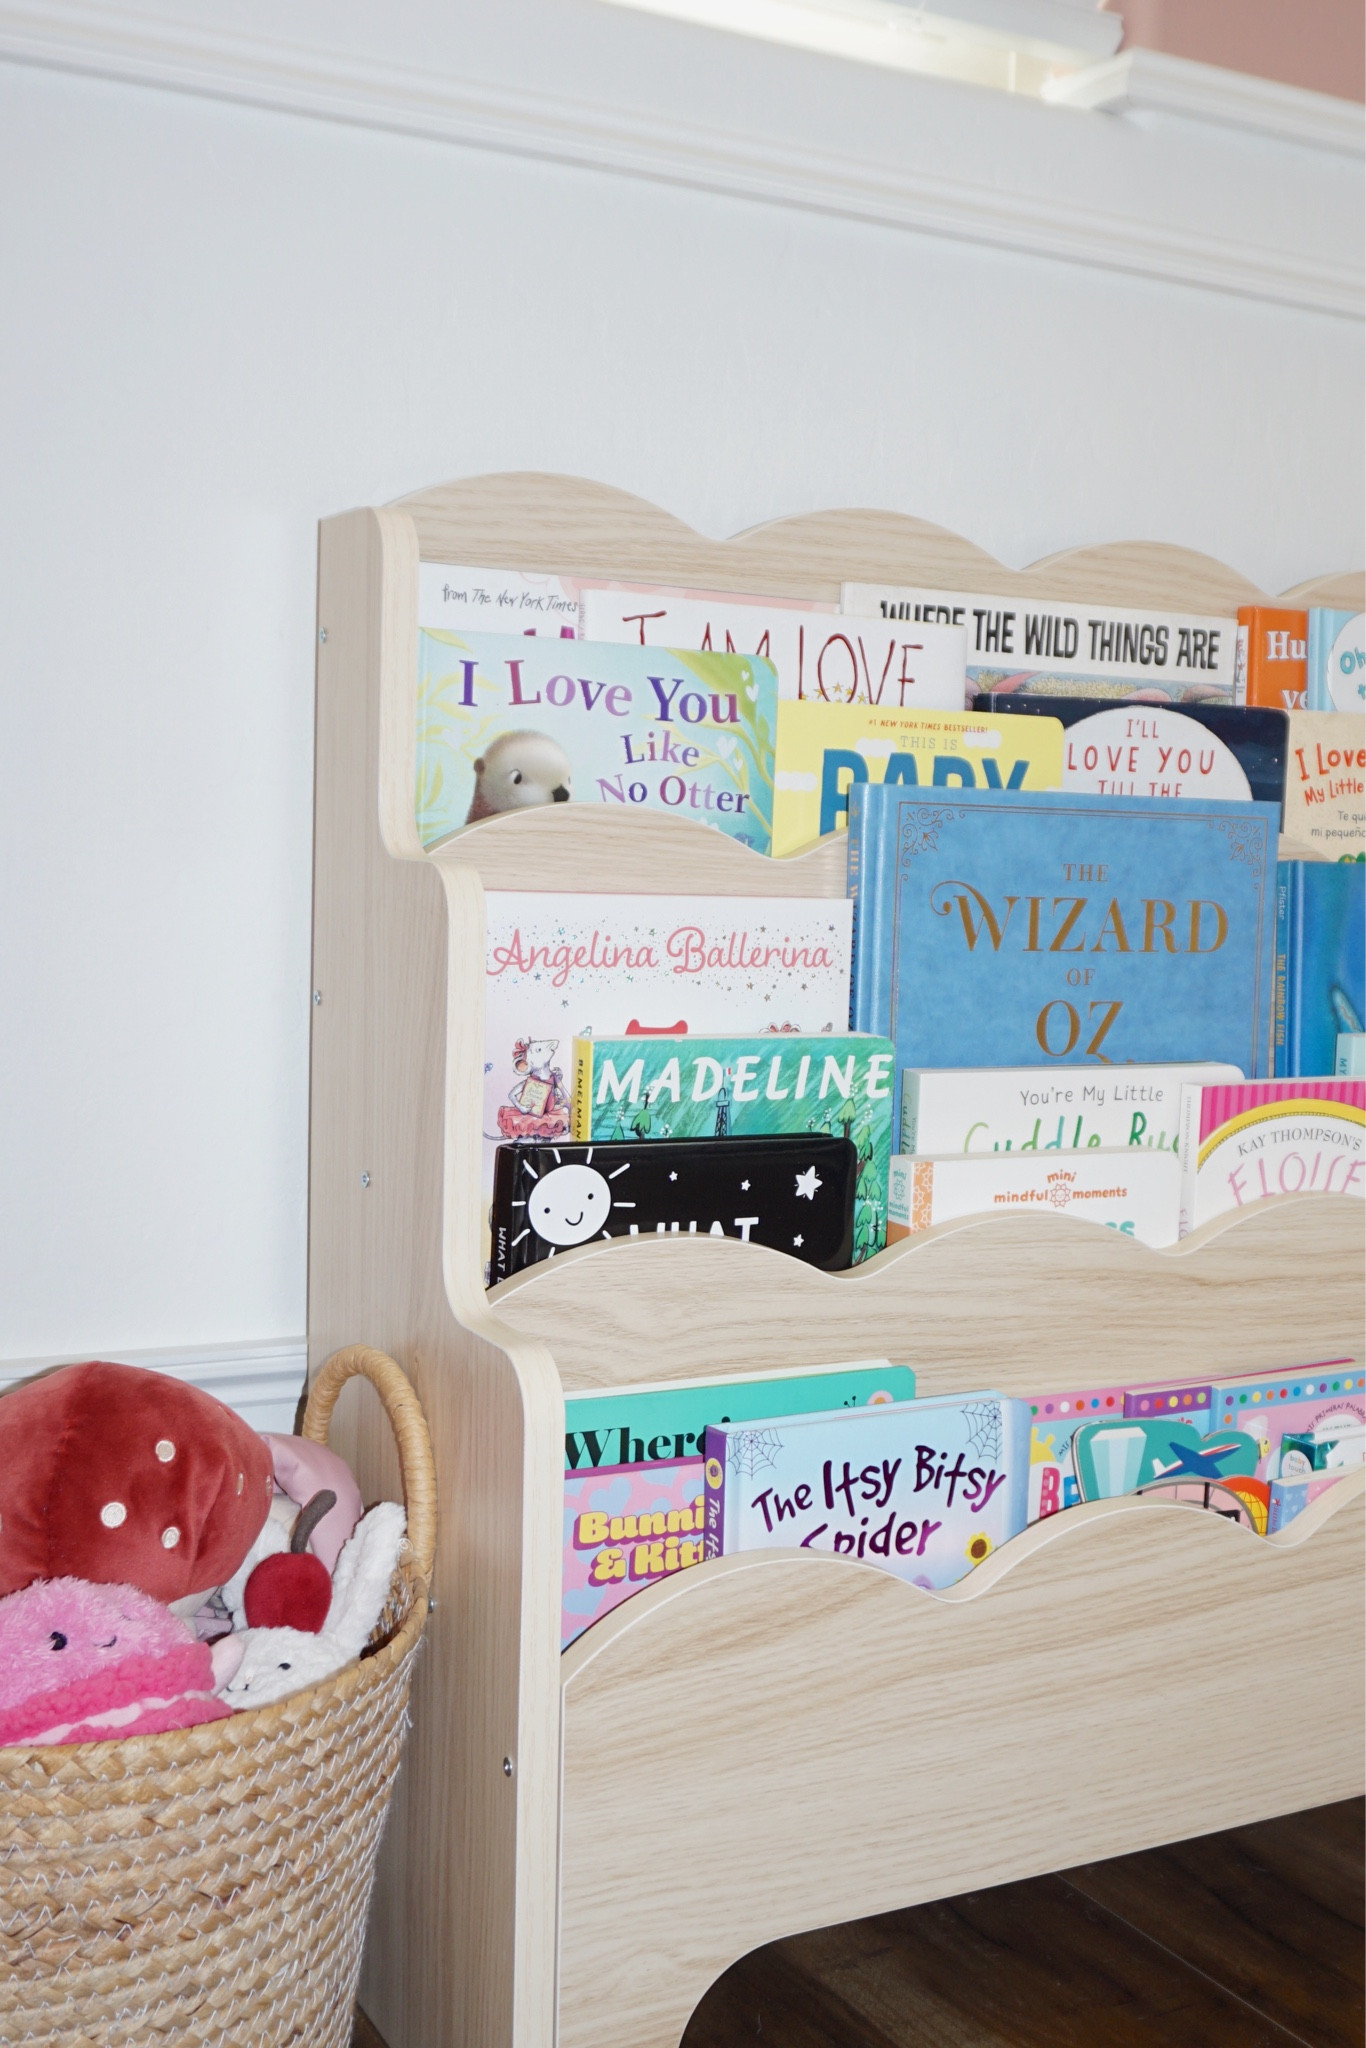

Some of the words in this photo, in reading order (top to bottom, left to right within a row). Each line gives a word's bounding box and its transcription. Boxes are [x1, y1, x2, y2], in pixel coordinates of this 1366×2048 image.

[442, 584, 467, 603] from
[472, 588, 492, 605] The
[496, 589, 518, 607] New
[519, 591, 544, 611] York
[546, 594, 578, 613] Times
[973, 608, 1016, 653] THE
[1025, 613, 1080, 659] WILD
[1088, 619, 1170, 666] THINGS
[1176, 627, 1222, 670] ARE
[458, 660, 478, 707] I
[504, 659, 633, 717] Love
[646, 676, 741, 724] You
[880, 720, 898, 728] NEW
[900, 722, 918, 730] YORK
[920, 722, 941, 731] TIMES
[944, 724, 988, 734] BESTSELLER!
[1126, 719, 1159, 739] I'LL
[620, 730, 700, 768] Like
[900, 736, 936, 749] THIS
[944, 738, 958, 751] IS
[1068, 742, 1140, 772] LOVE
[1158, 746, 1215, 775] YOU
[1295, 747, 1310, 782] I
[1316, 742, 1366, 776] Love
[596, 773, 648, 804] No
[659, 776, 750, 815] Otter
[1304, 786, 1325, 807] My
[1328, 778, 1364, 799] Little
[1338, 810, 1349, 821] Te
[1311, 828, 1322, 836] mi
[1063, 863, 1110, 882] THE
[930, 880, 1229, 954] WIZARD
[1278, 886, 1287, 920] Pfister
[486, 928, 659, 988] Angelina
[666, 926, 835, 974] Ballerina
[1277, 954, 1286, 972] THE
[1066, 968, 1096, 987] OF
[1276, 974, 1286, 1021] RAINBOW
[1036, 1000, 1128, 1063] OZ
[1276, 1024, 1284, 1046] FISH
[596, 1054, 893, 1105] MADELINE
[1020, 1087, 1074, 1106] You're
[1083, 1086, 1105, 1106] My
[1114, 1084, 1164, 1102] Little
[576, 1058, 584, 1142] BEMELMAN
[1238, 1134, 1266, 1156] KAY
[1271, 1128, 1362, 1151] THOMPSON'S
[1047, 1170, 1077, 1184] mini
[994, 1190, 1048, 1204] mindful
[1072, 1186, 1128, 1199] moments
[497, 1226, 507, 1272] WHAT
[751, 1482, 814, 1534] The
[822, 1458, 902, 1516] Itsy
[912, 1444, 1006, 1513] Bitsy
[709, 1498, 720, 1529] The
[592, 1548, 627, 1583] &
